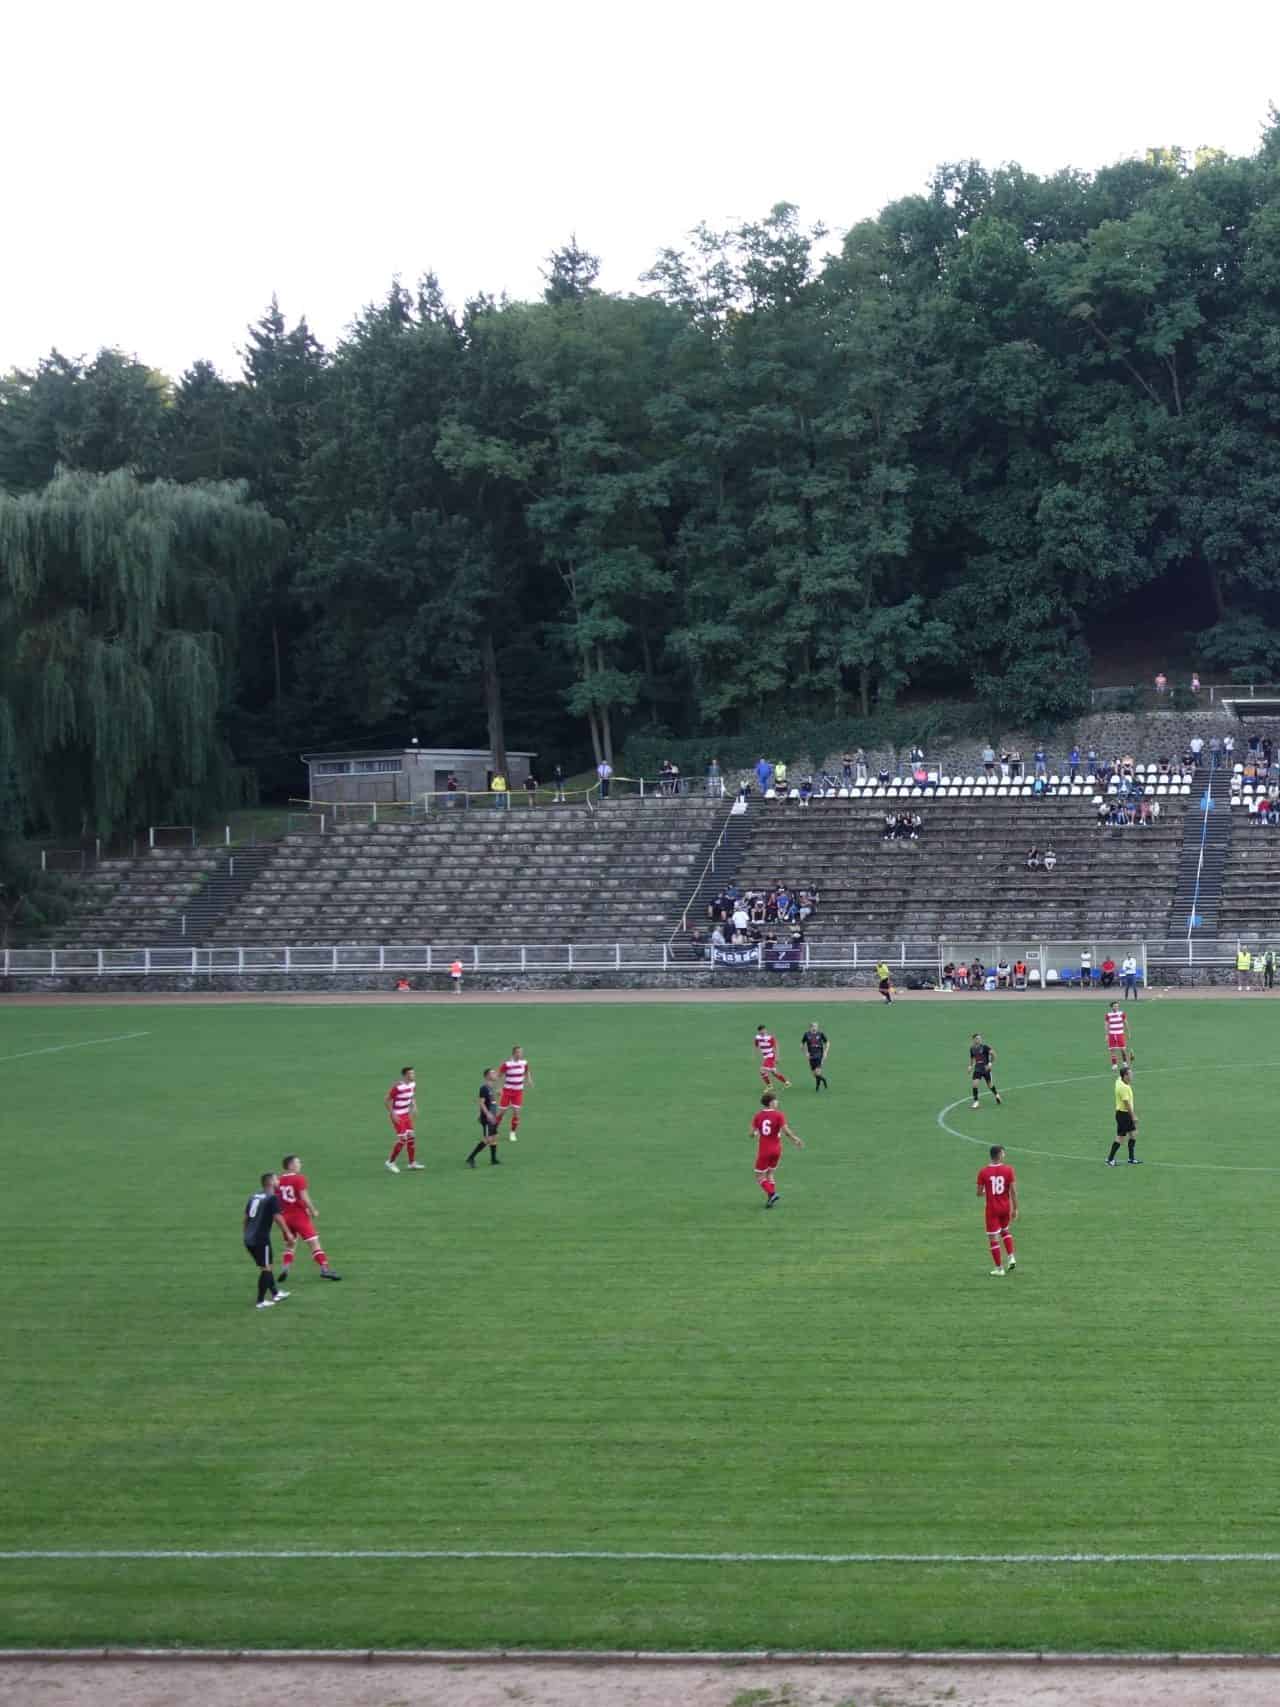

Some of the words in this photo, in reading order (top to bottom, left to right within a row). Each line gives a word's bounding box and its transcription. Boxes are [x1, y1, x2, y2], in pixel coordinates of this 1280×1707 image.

[762, 1119, 772, 1136] 6
[279, 1185, 297, 1203] 13
[989, 1175, 1005, 1195] 18
